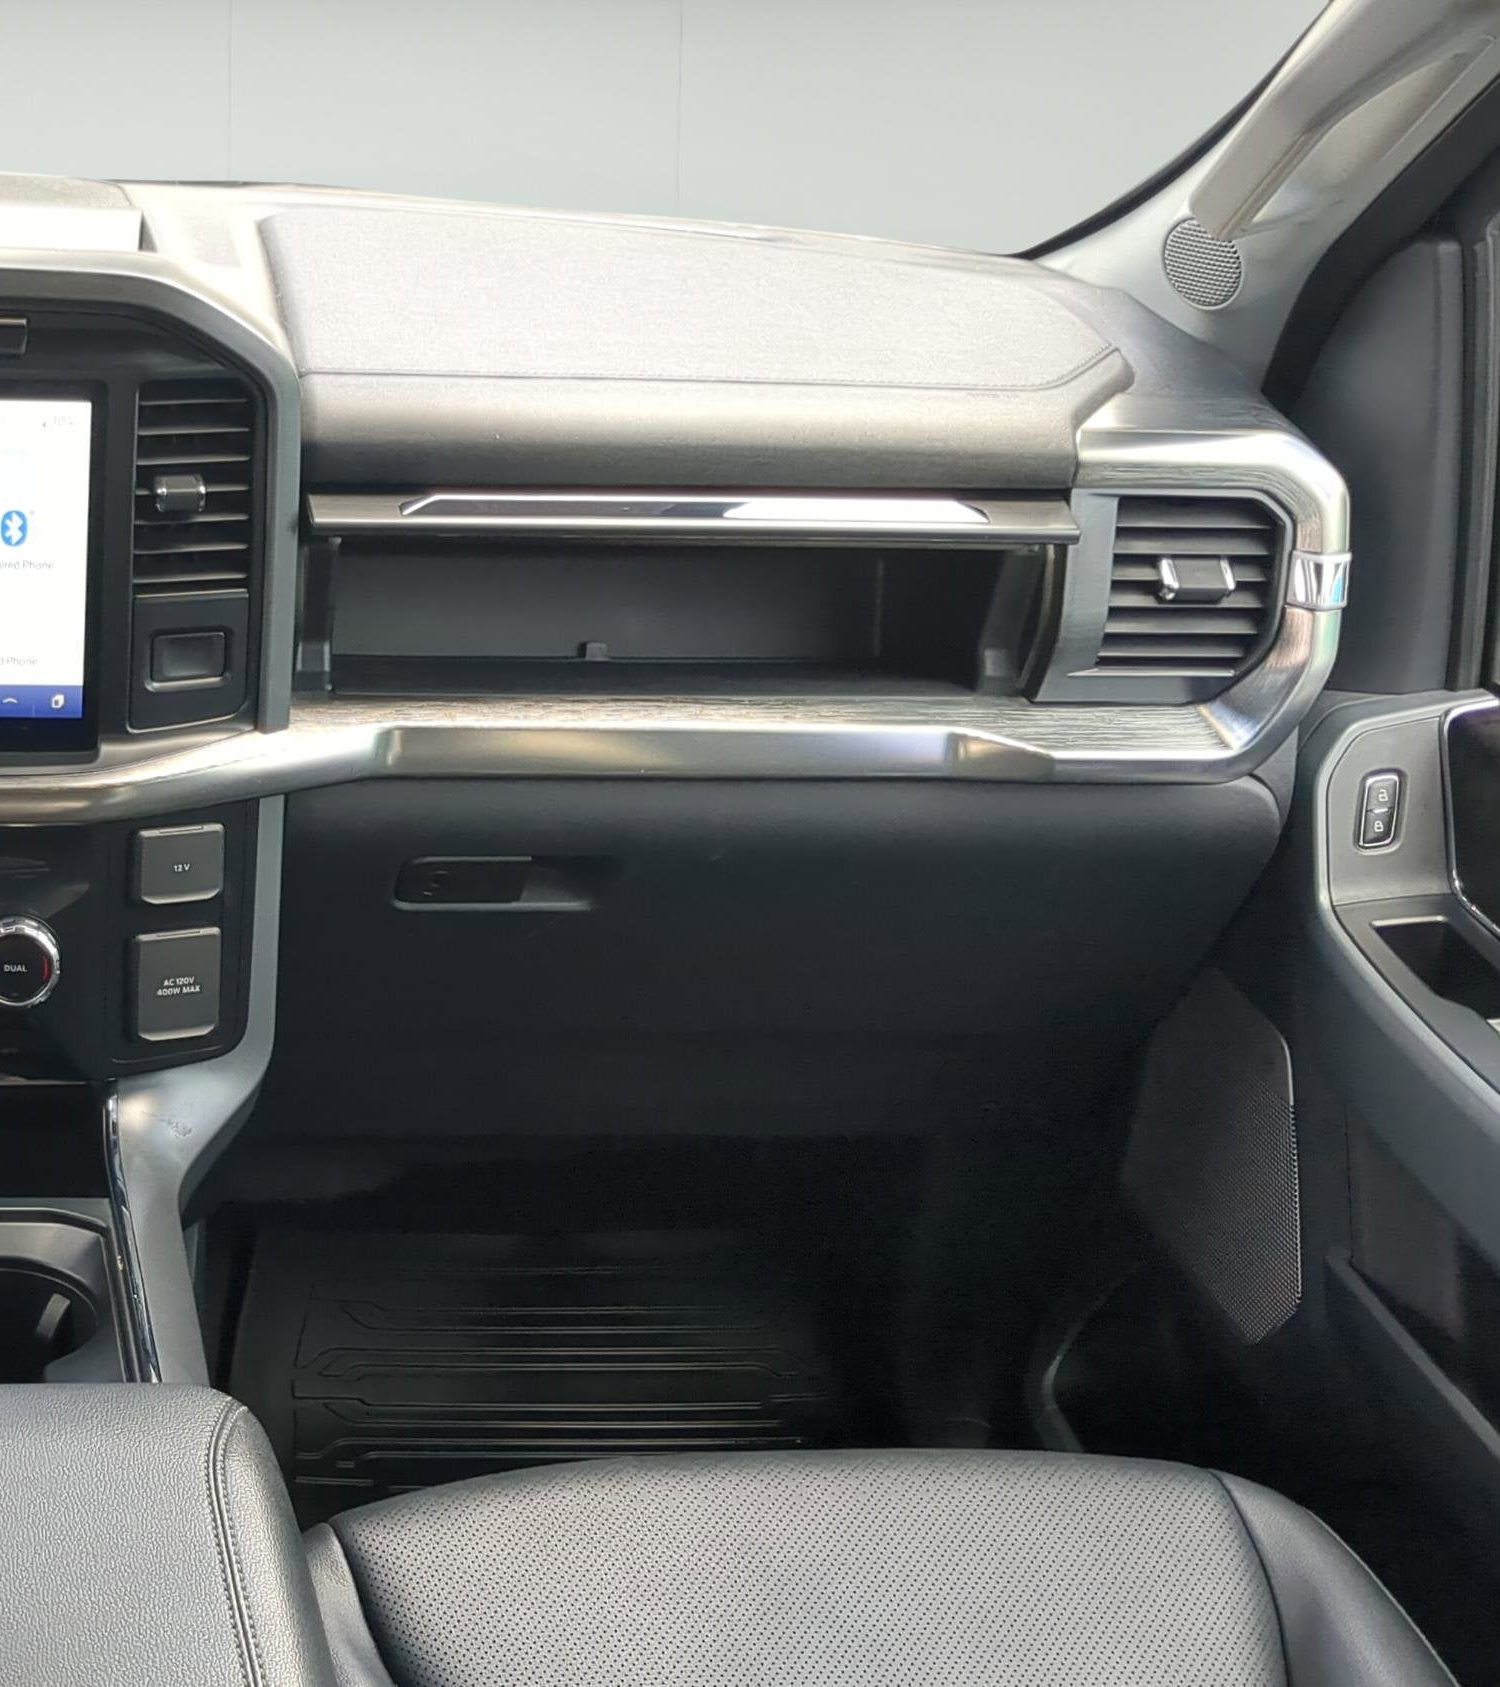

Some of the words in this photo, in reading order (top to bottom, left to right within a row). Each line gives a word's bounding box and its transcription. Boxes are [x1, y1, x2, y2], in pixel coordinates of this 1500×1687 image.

[22, 559, 54, 570] Phone
[3, 964, 28, 973] DUAL
[163, 978, 175, 987] AC
[157, 986, 181, 997] 400W
[182, 984, 201, 994] MAX
